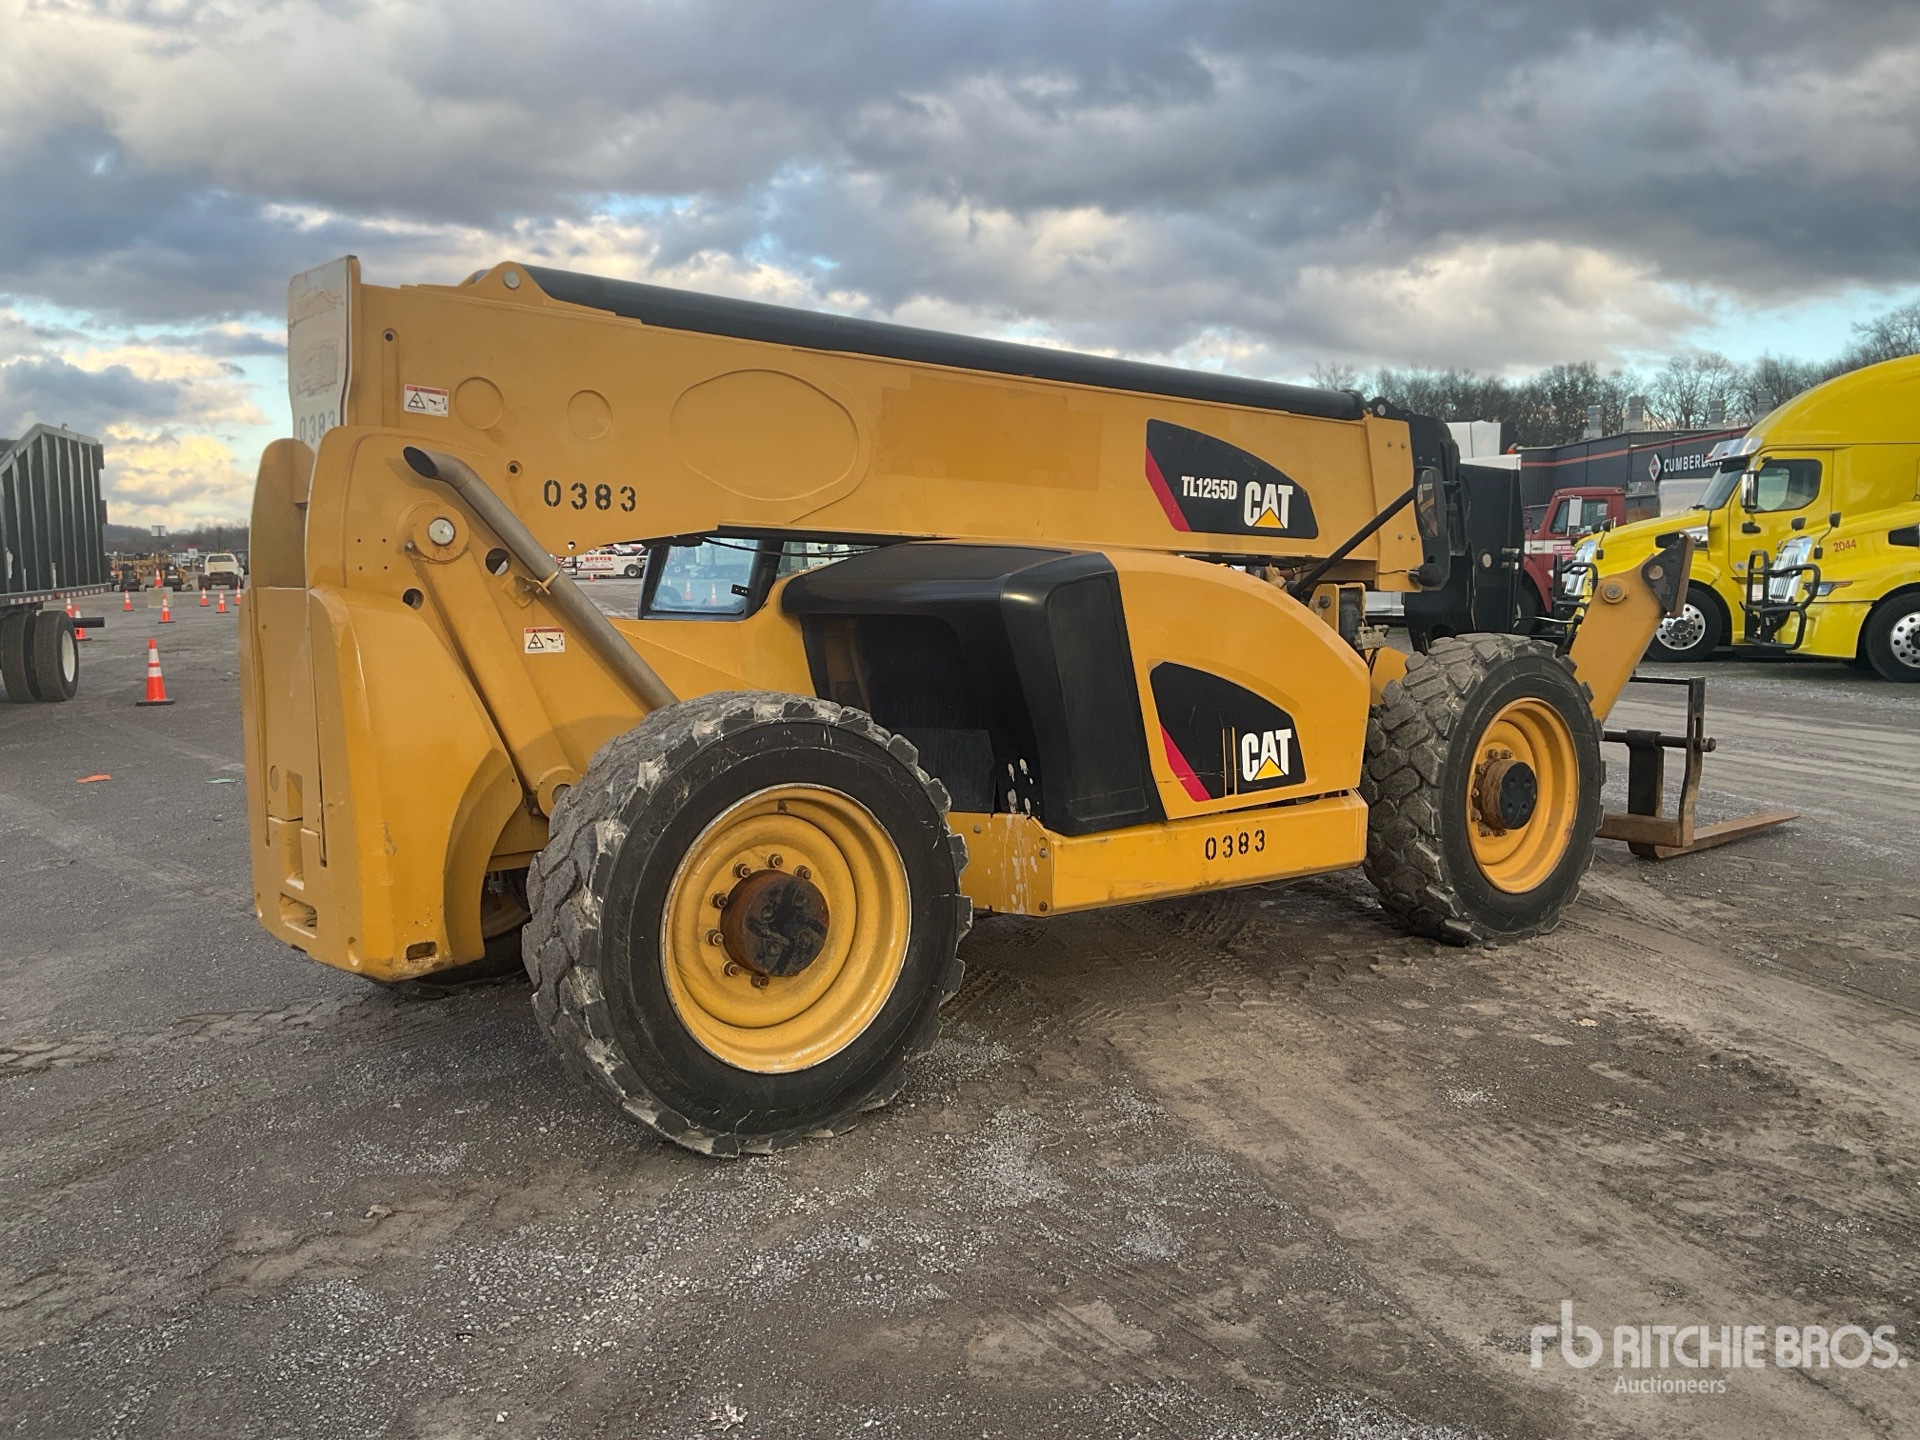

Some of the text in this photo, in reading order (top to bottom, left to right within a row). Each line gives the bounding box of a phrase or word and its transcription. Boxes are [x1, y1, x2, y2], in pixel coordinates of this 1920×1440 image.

[1663, 453, 1723, 473] CUMBERL
[544, 479, 636, 512] 0383
[1181, 475, 1238, 500] TL1255D
[1243, 481, 1294, 530] CAT
[1833, 538, 1857, 553] 2044
[1241, 728, 1293, 782] CAT
[1205, 829, 1266, 860] 0383
